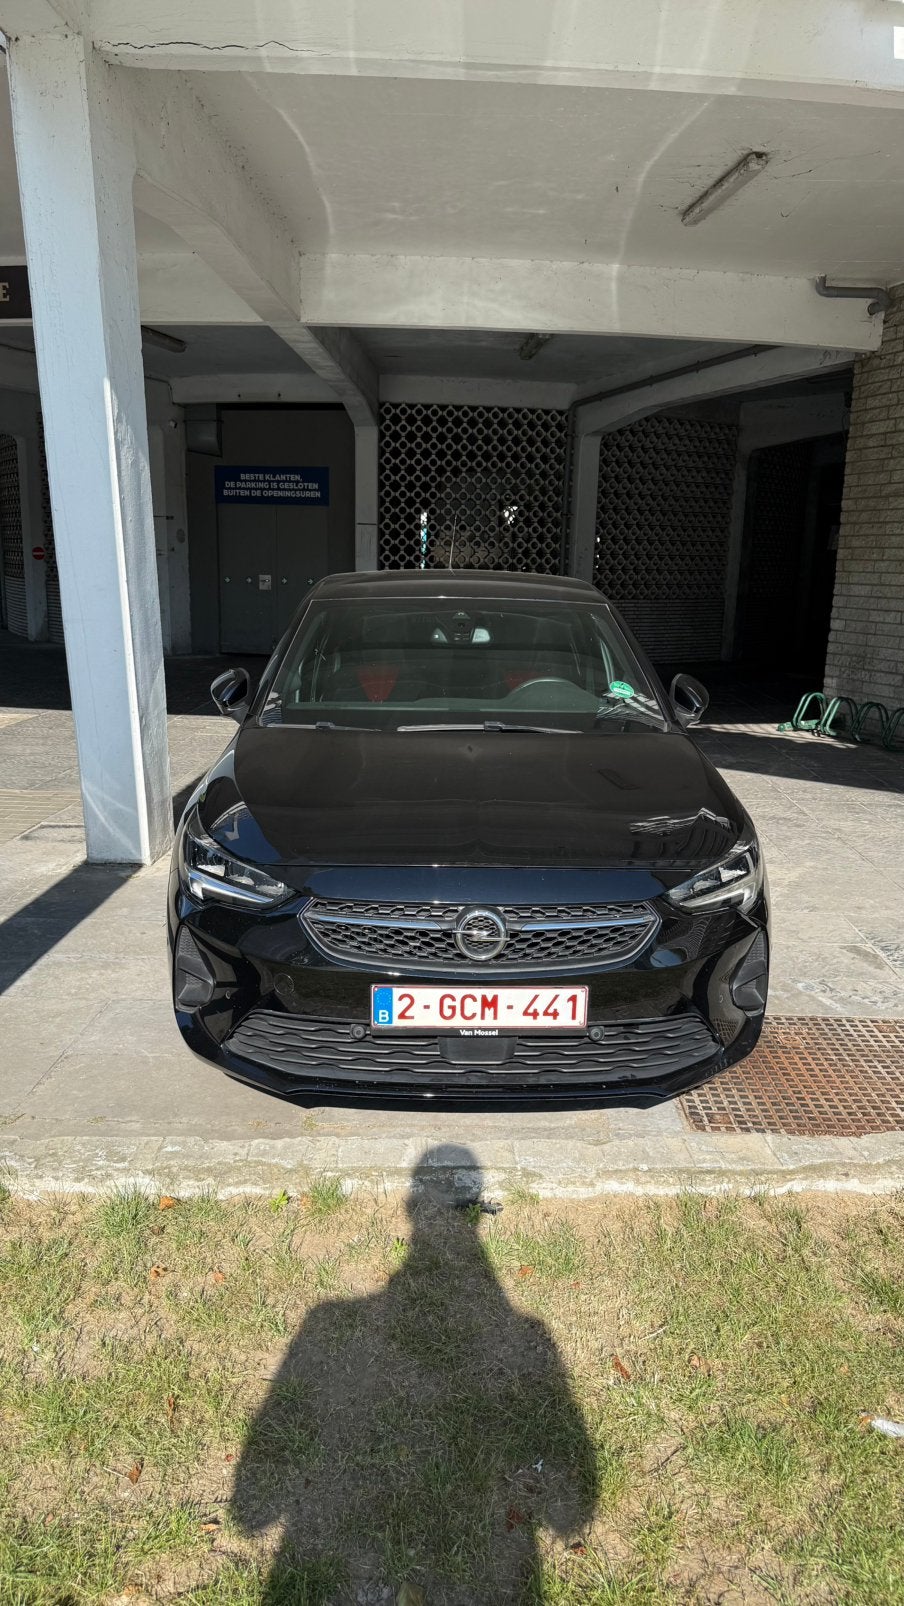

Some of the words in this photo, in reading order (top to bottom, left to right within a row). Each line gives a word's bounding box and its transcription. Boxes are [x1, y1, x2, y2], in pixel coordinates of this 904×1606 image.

[240, 473, 264, 481] BESTE
[265, 474, 303, 482] KLANTEN,
[237, 481, 270, 489] PARKING
[279, 482, 319, 490] GESLOTEN
[223, 489, 250, 497] BUITEN
[263, 490, 321, 498] OPENINGSUREN
[397, 993, 578, 1021] 2-GCM-441
[378, 1010, 390, 1023] B
